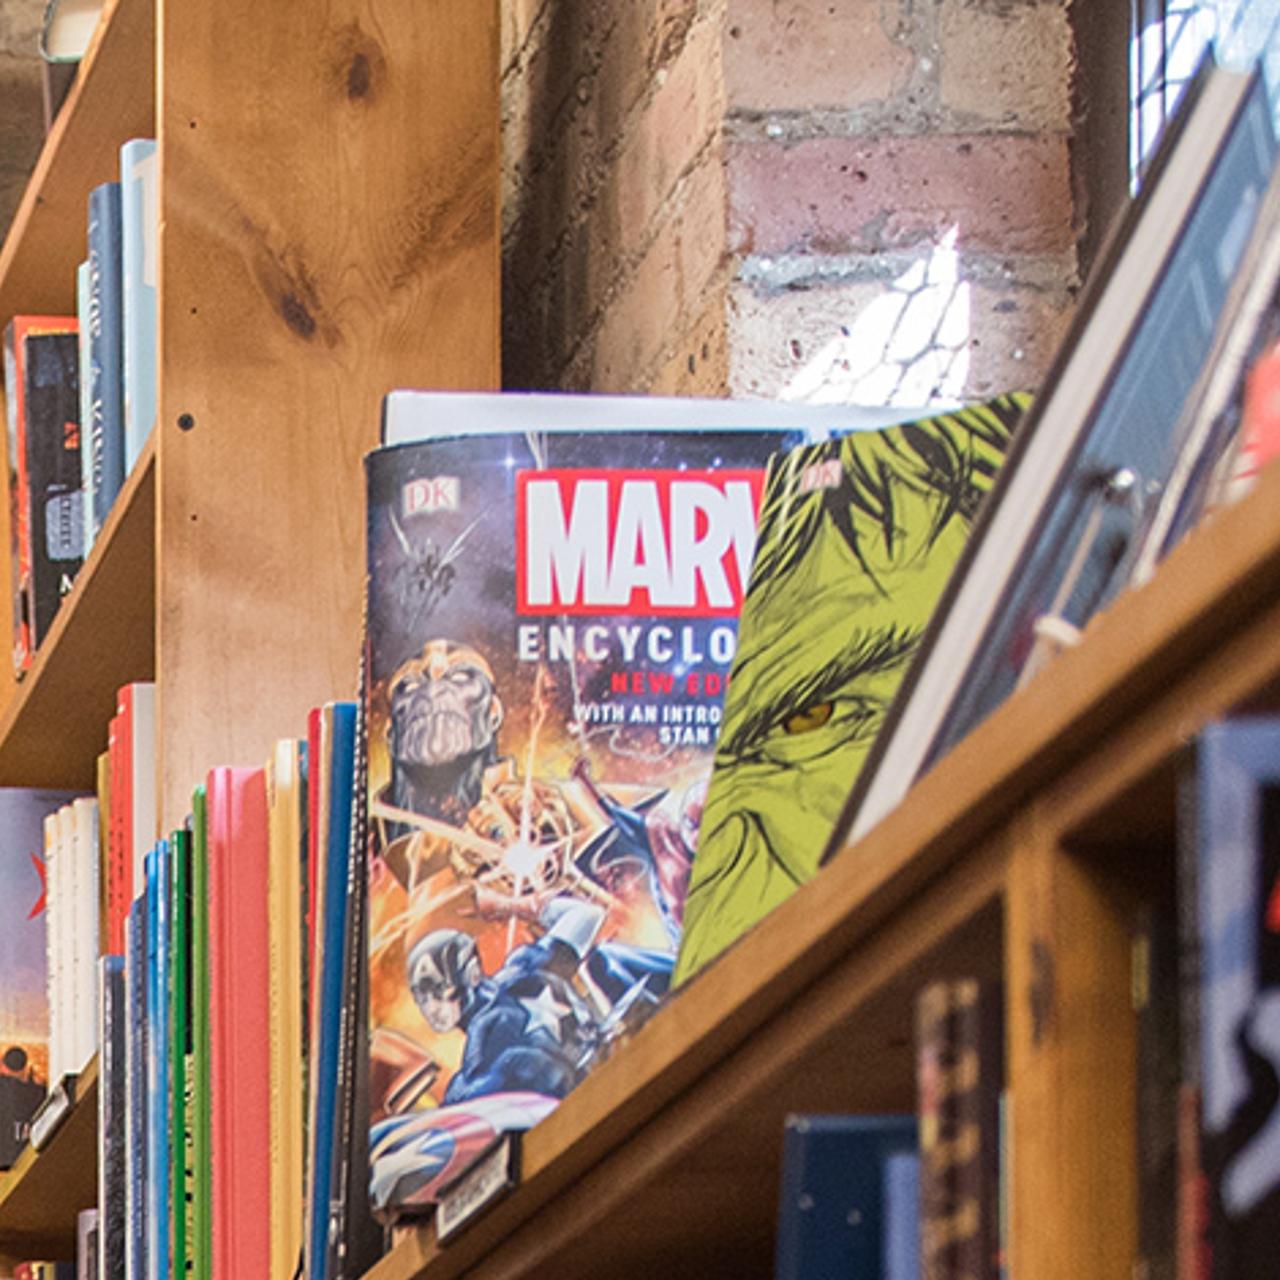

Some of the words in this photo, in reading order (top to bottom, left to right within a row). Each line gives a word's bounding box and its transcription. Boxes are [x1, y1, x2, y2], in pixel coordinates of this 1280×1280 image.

[406, 482, 450, 510] DK
[610, 672, 676, 694] NEW
[572, 705, 624, 723] WITH
[630, 705, 657, 723] AN
[659, 726, 709, 745] STAN
